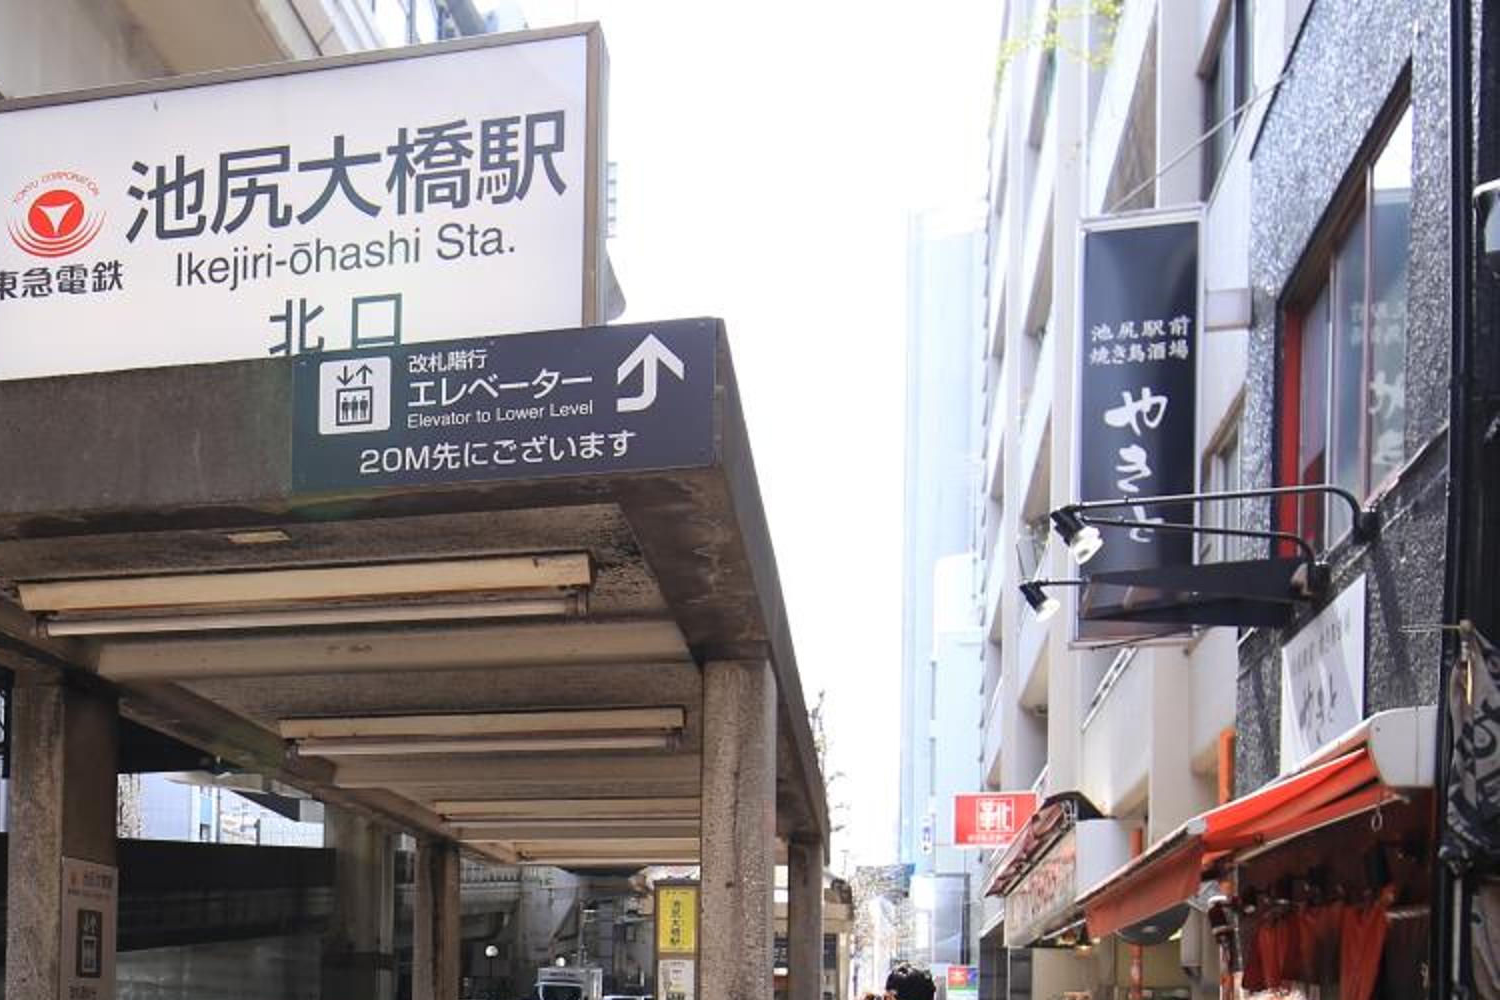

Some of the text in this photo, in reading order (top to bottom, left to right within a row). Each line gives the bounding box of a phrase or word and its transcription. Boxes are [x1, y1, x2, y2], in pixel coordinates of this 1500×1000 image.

[125, 110, 568, 246] 池尻大橋駅
[436, 222, 516, 261] Sta.
[269, 293, 402, 356] 北口
[408, 349, 489, 374] 改札階行
[408, 367, 594, 407] エレベーター
[407, 398, 594, 430] Elevator to Lower Level
[359, 429, 636, 474] 20M先にございます
